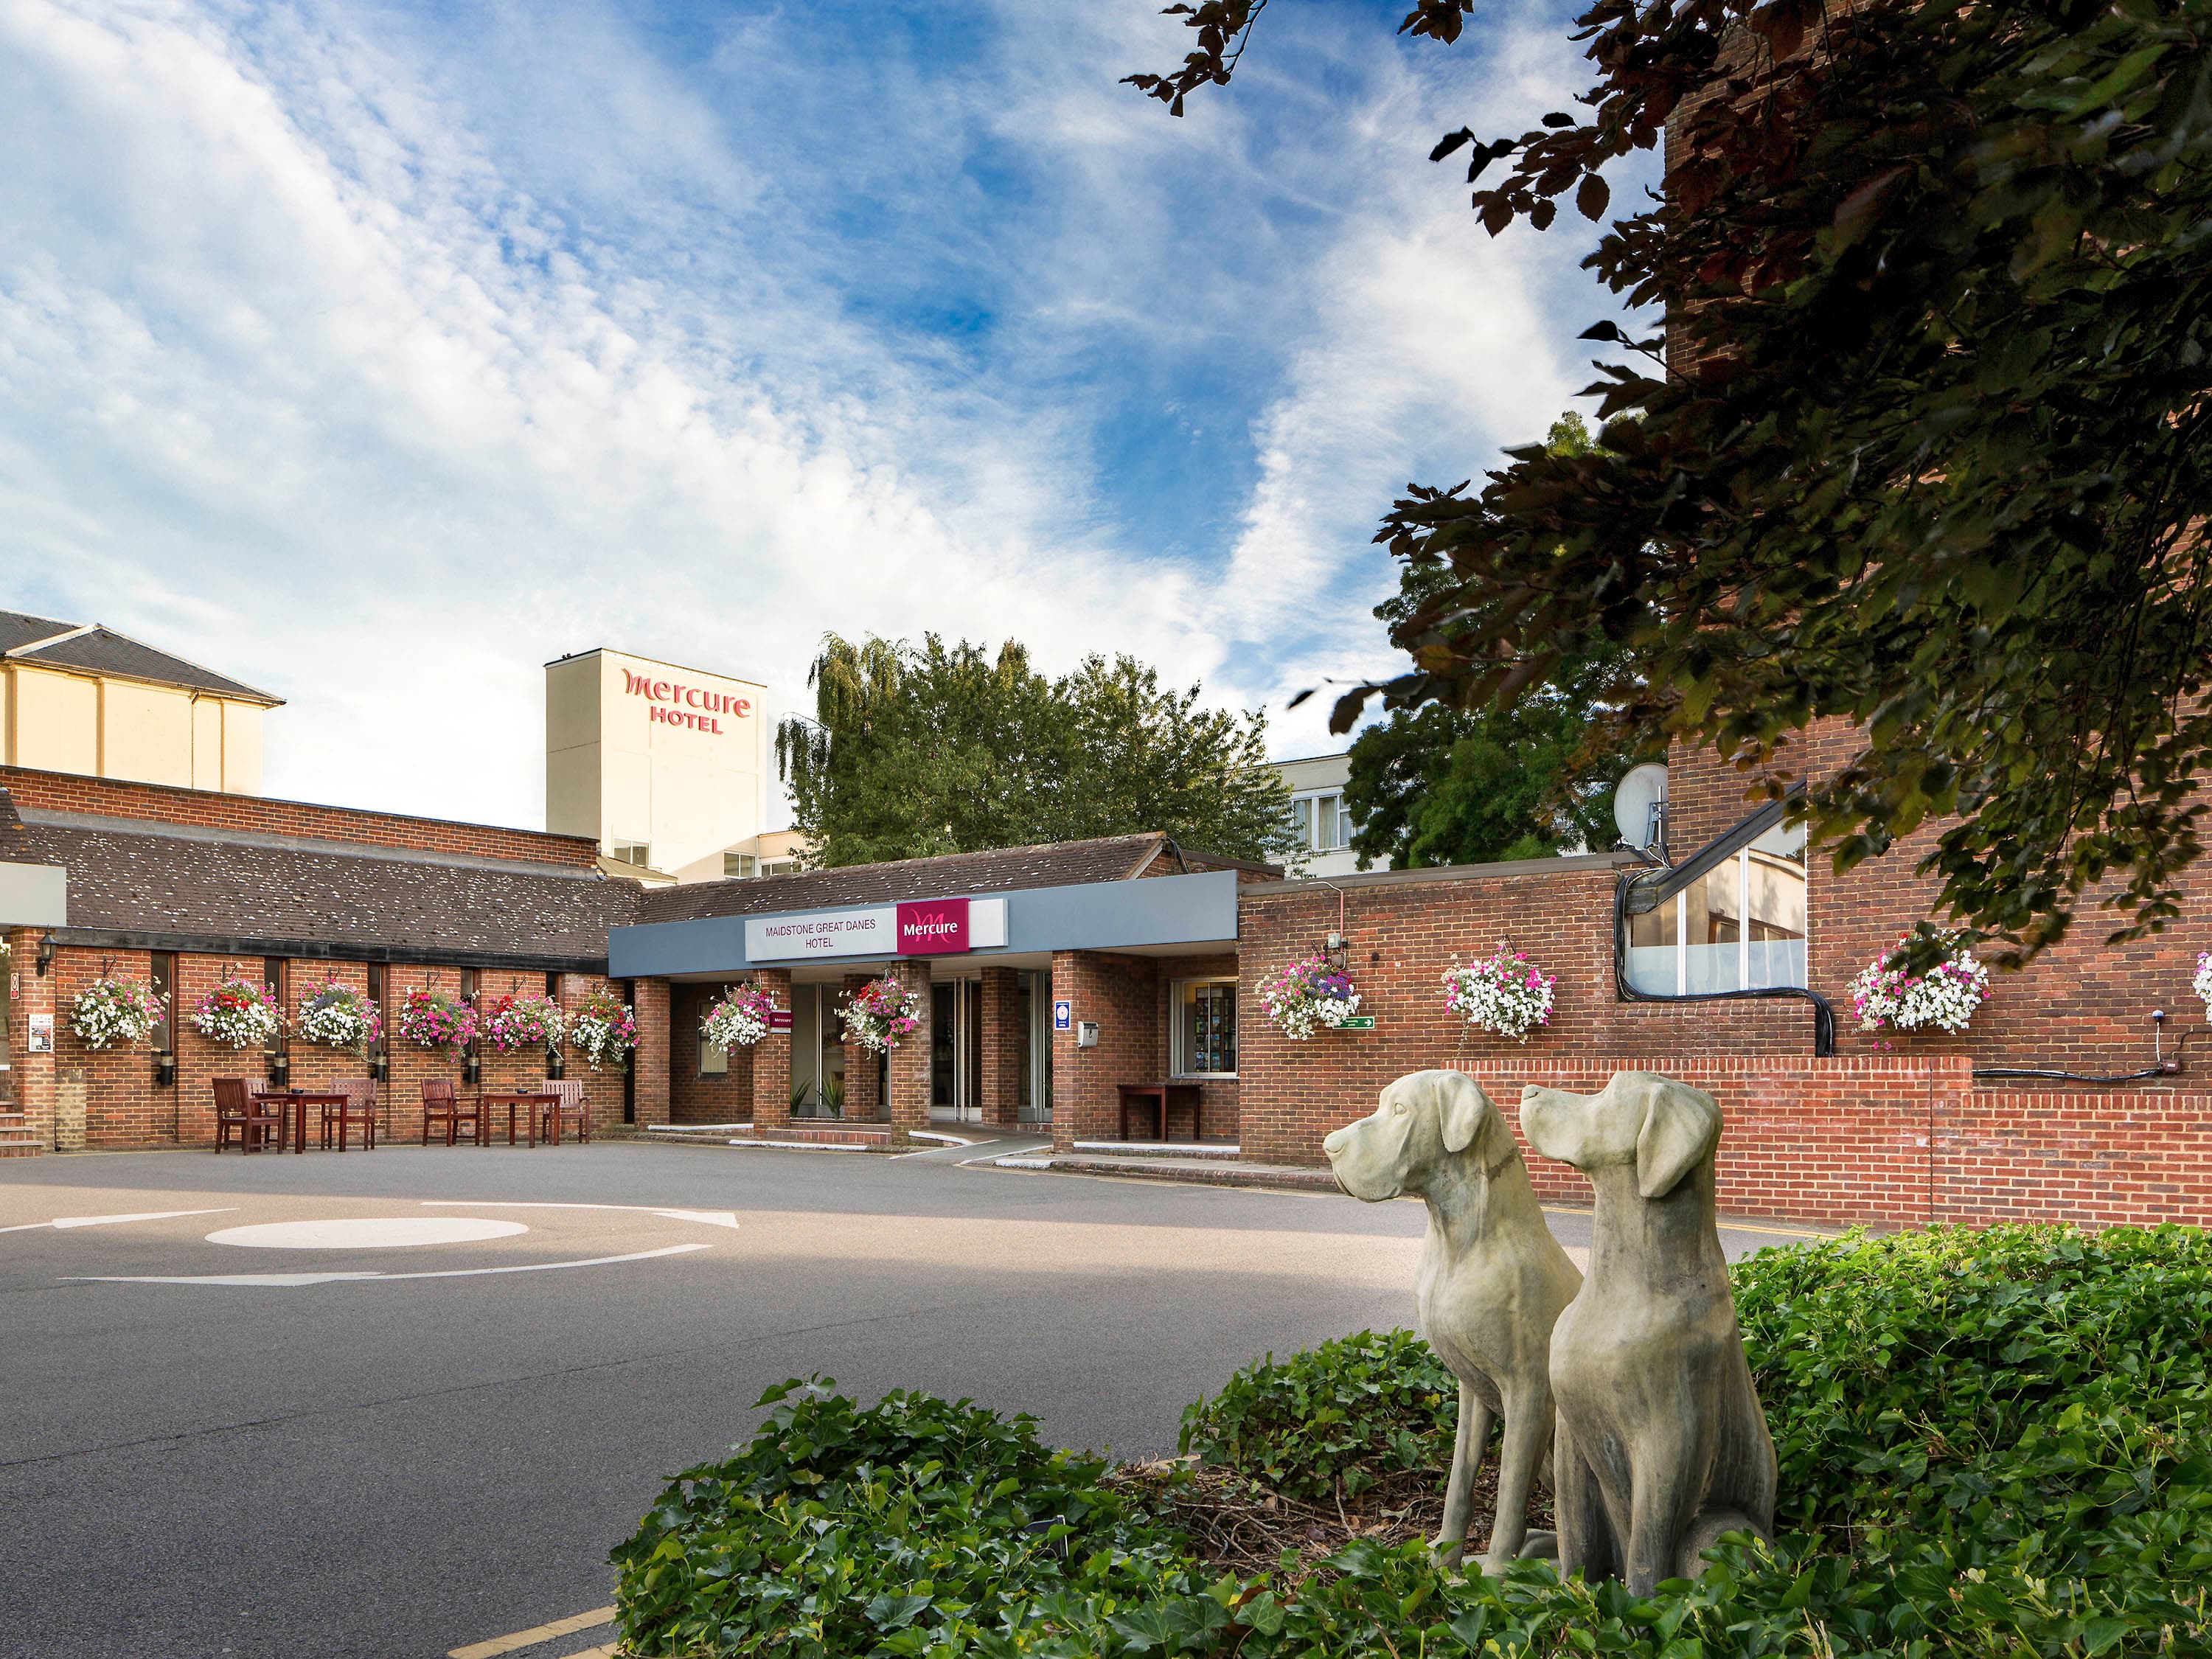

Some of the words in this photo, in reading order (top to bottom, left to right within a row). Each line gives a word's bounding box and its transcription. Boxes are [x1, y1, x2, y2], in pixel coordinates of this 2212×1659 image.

[650, 706, 723, 735] HOTEL
[765, 924, 814, 937] MAIDSTONE
[815, 921, 844, 933] GREAT
[846, 919, 876, 931] DANES
[904, 922, 959, 936] Mercure
[805, 937, 834, 949] HOTEL
